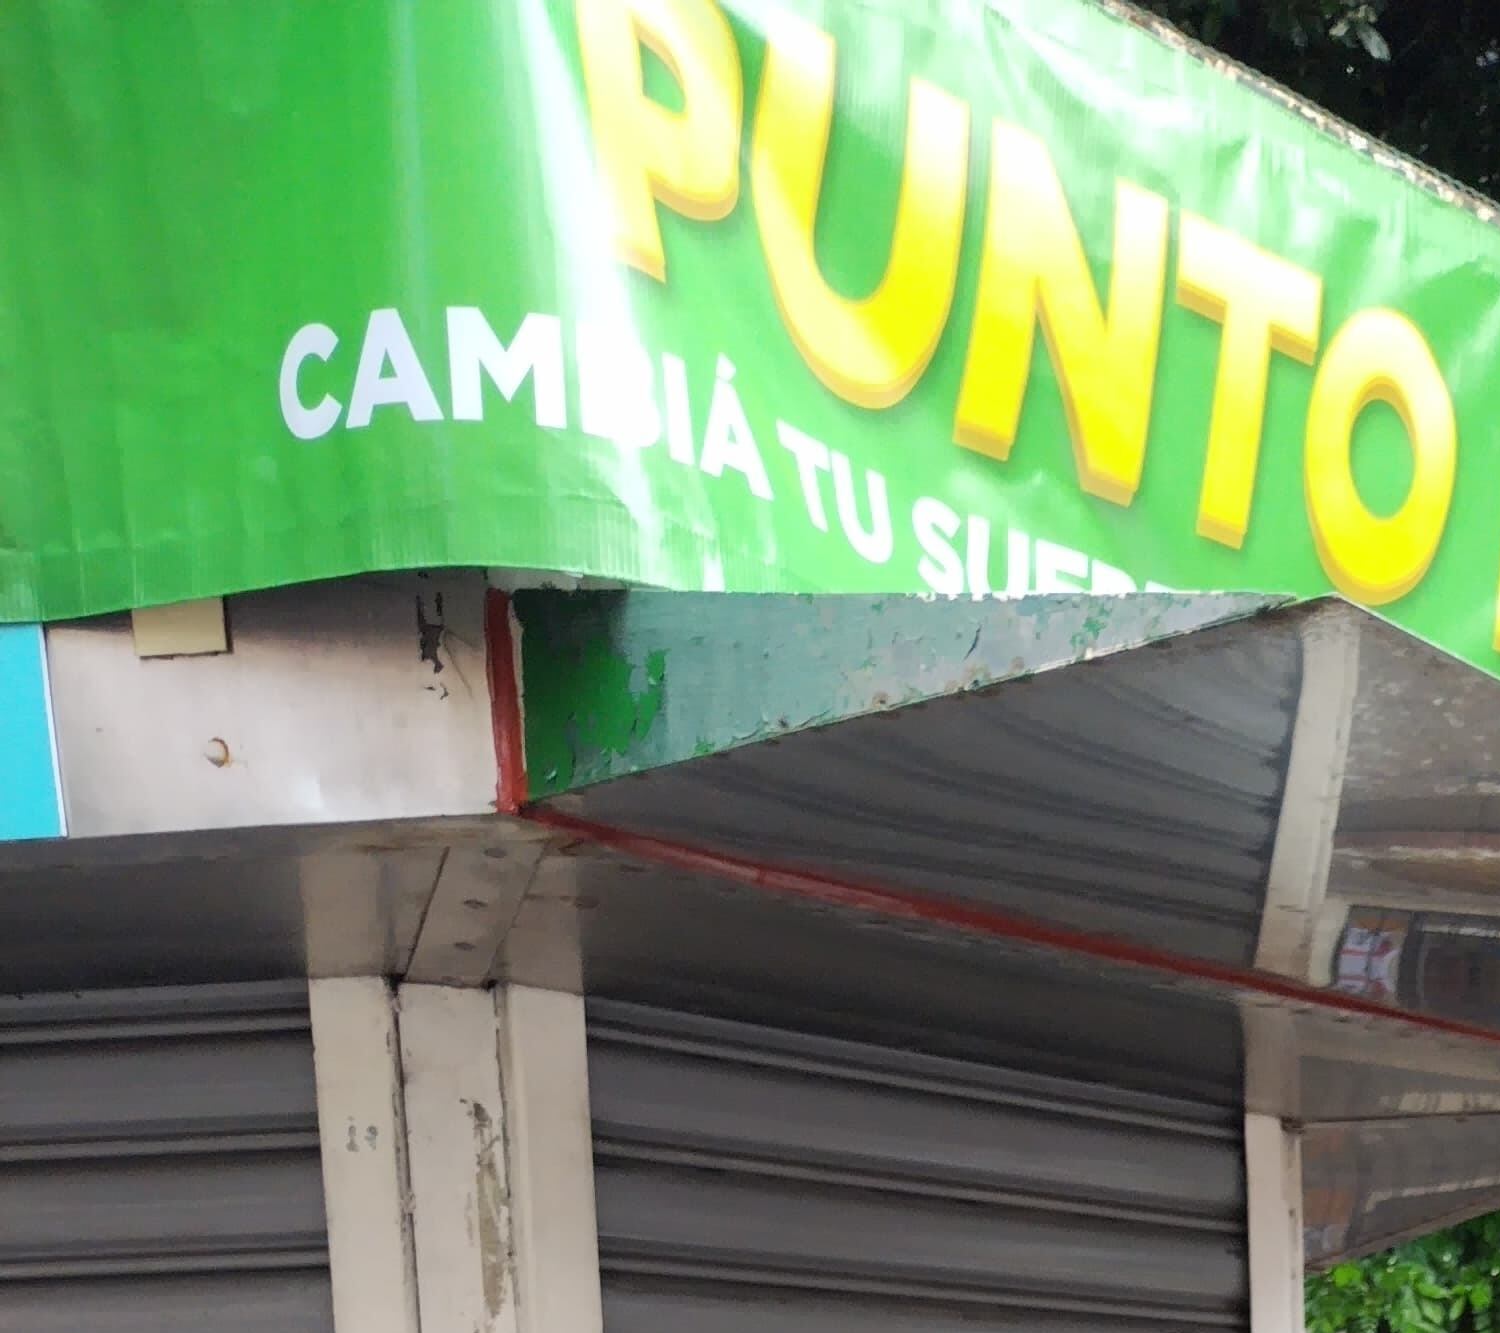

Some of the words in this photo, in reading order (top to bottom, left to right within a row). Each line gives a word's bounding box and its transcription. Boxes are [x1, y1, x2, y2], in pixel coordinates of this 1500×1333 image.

[279, 305, 774, 501] CAMBIÁ
[776, 418, 894, 564] TU
[575, 0, 1457, 605] PUNTO
